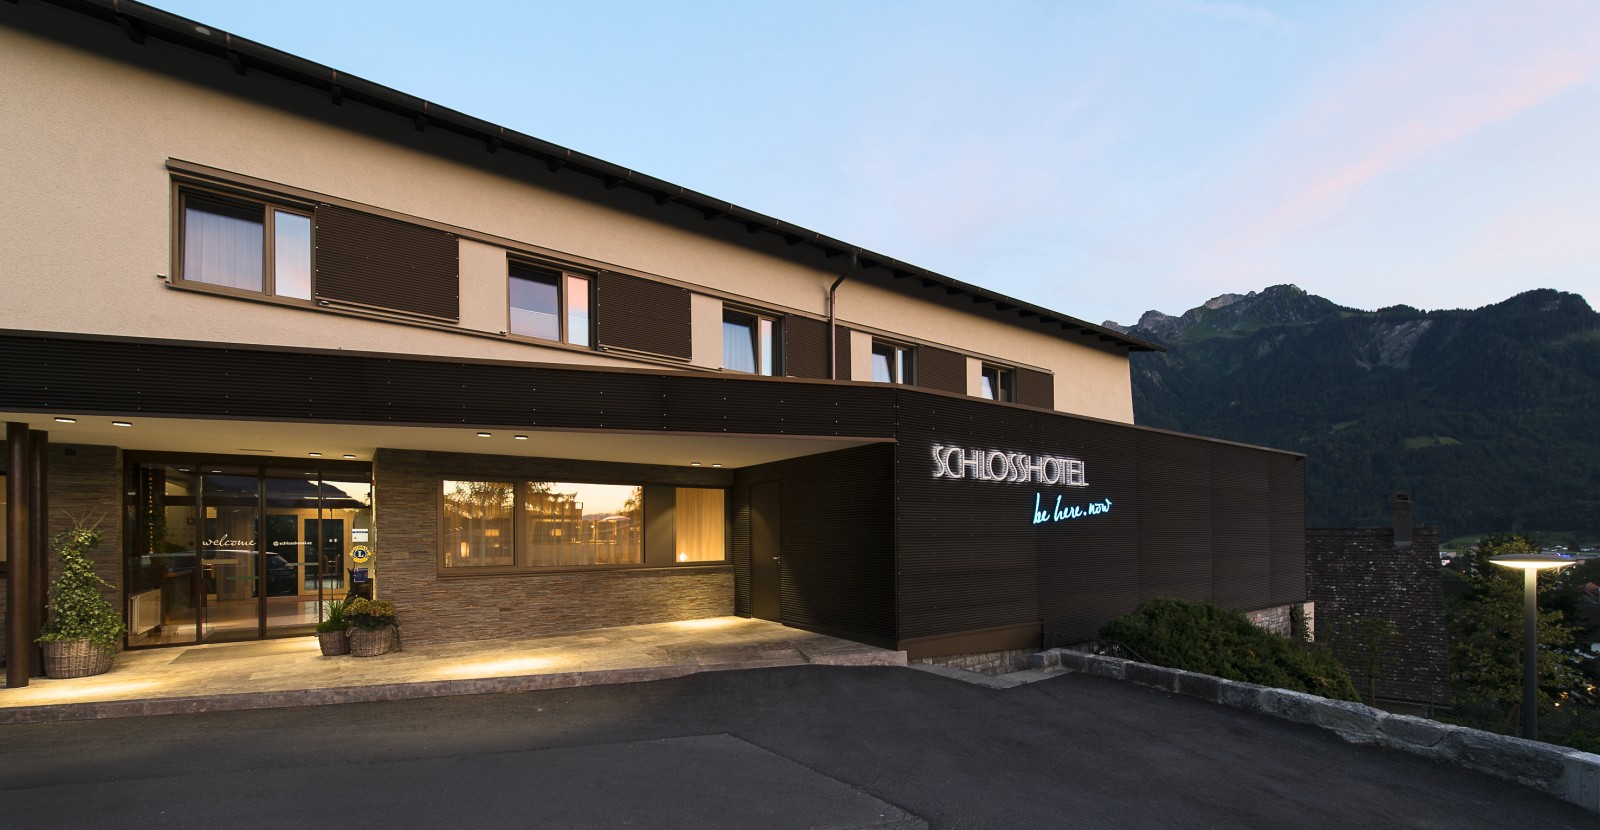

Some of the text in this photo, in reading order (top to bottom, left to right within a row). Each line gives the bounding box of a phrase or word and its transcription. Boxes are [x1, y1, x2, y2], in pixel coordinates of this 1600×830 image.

[932, 445, 1090, 487] SCHLOSSHOTEL
[1033, 492, 1050, 524] be
[202, 533, 256, 547] welcome
